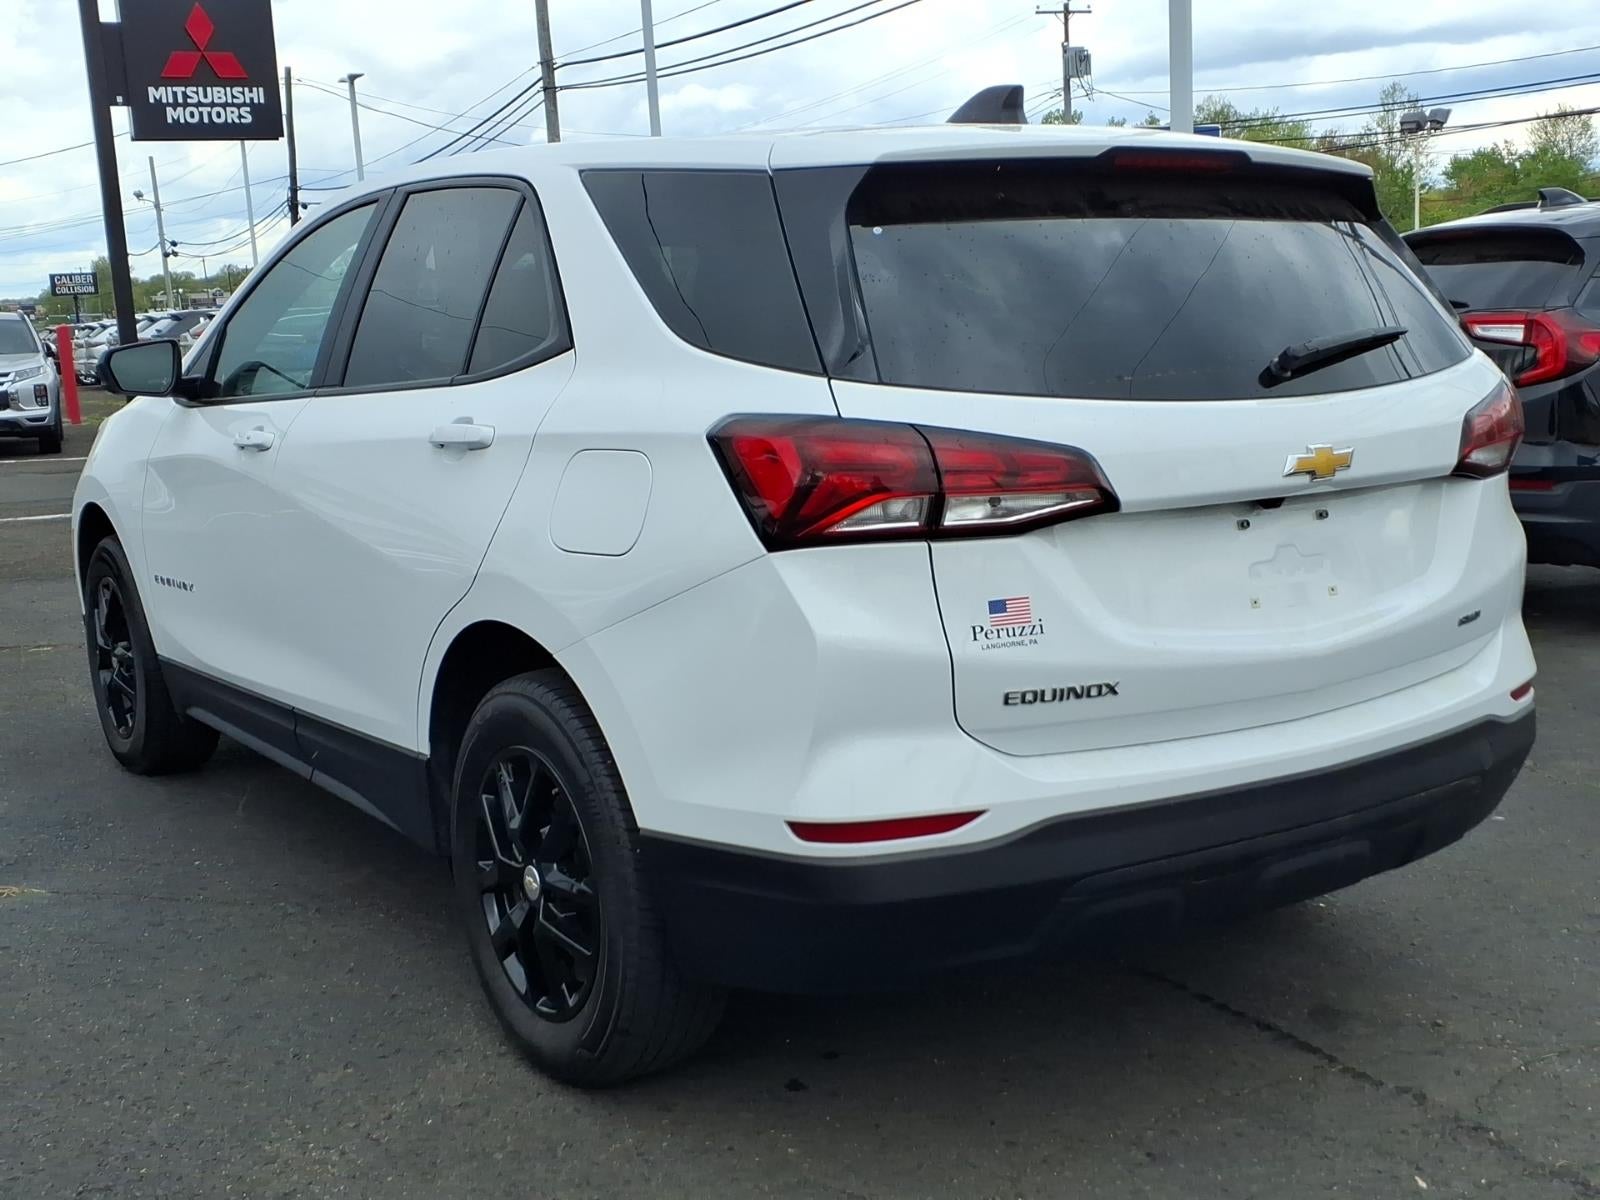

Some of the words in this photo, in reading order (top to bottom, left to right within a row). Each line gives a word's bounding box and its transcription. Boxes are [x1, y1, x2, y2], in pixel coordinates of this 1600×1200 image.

[147, 86, 265, 104] MITSUBISHI
[165, 106, 253, 124] MOTORS
[54, 274, 94, 285] CALIBER
[55, 285, 95, 294] COLLISION
[971, 617, 1045, 642] Peruzzi
[981, 639, 1028, 651] LANGHORNE,
[1028, 638, 1039, 646] PA
[1003, 681, 1120, 706] EQUINOX
